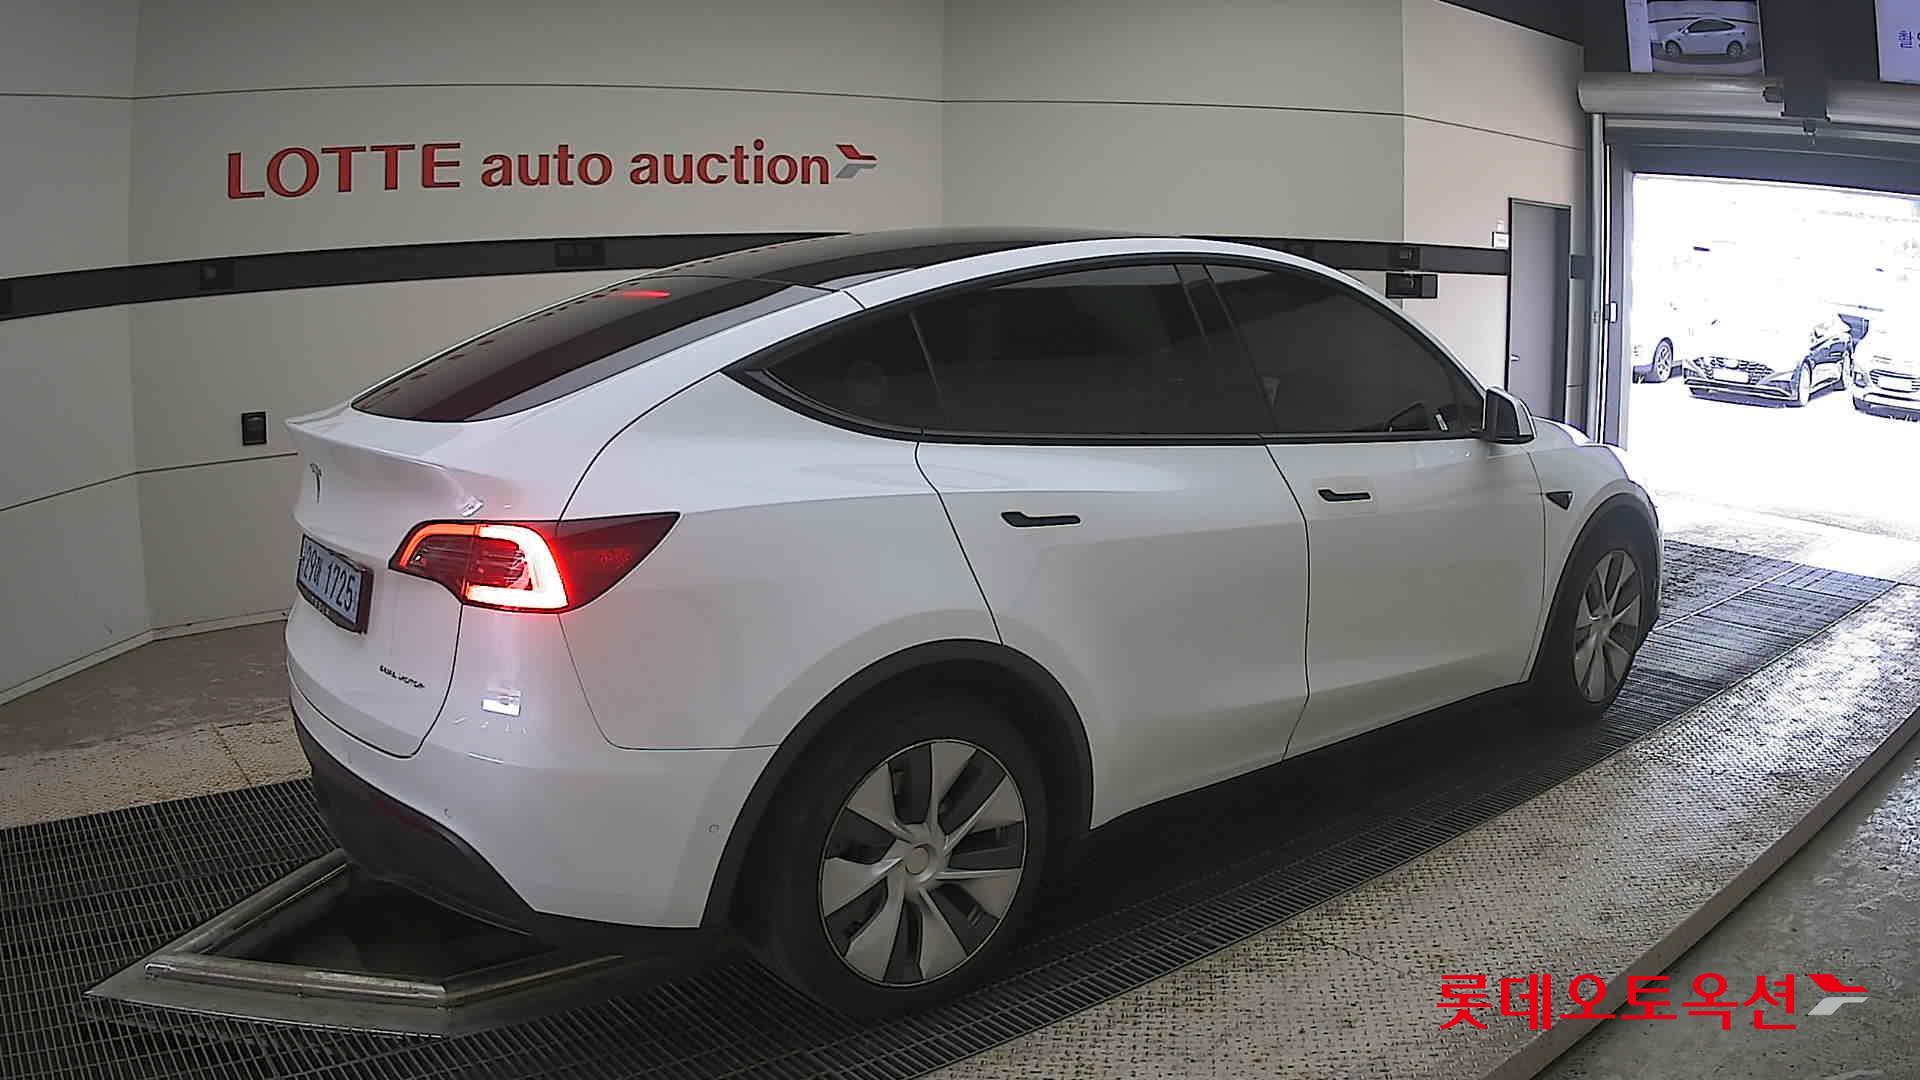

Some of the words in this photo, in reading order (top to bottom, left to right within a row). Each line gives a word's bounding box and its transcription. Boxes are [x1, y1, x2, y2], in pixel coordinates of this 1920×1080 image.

[227, 142, 461, 200] LOTTE
[480, 144, 613, 187] auto
[629, 138, 831, 186] auction
[324, 561, 356, 612] 1725
